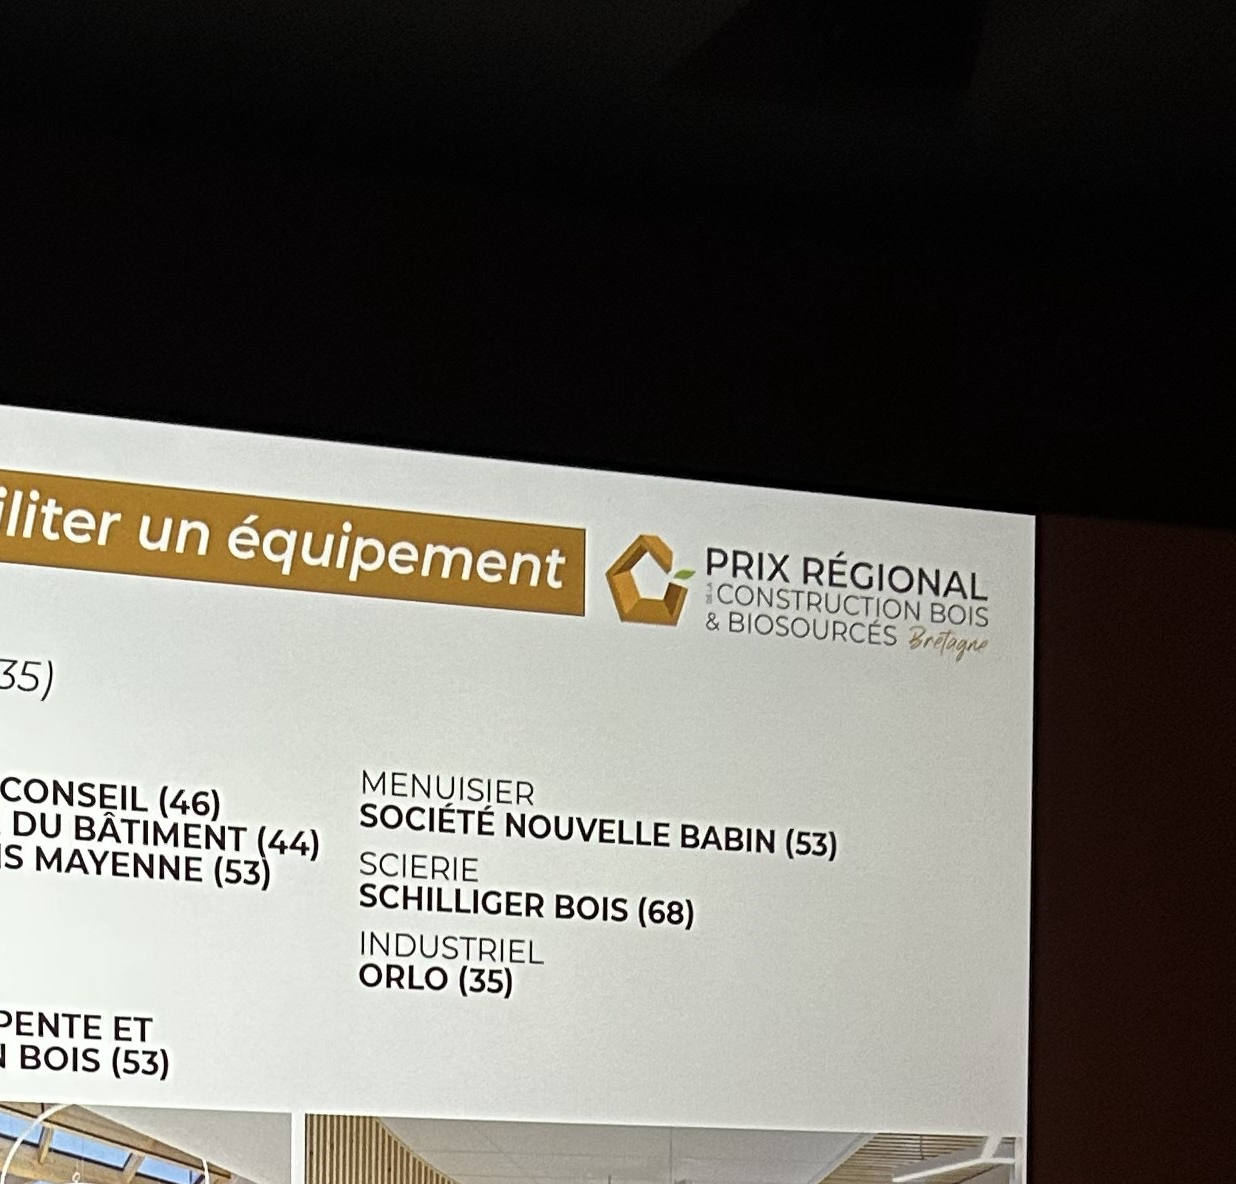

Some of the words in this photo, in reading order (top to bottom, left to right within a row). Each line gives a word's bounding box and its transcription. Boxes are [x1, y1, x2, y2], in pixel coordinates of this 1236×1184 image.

[138, 514, 210, 555] un
[227, 514, 566, 588] équipement
[706, 546, 790, 584] PRIX
[802, 550, 989, 602] RÉGIONAL
[716, 583, 922, 622] CONSTRUCTION
[930, 602, 989, 628] BOIS
[705, 611, 720, 632] &
[728, 610, 898, 647] BIOSOURCÉS
[908, 625, 989, 662] Bretagne
[0, 776, 149, 813] CONSEIL
[159, 785, 221, 823] (46)
[362, 769, 534, 807] MENUISIER
[12, 809, 62, 840] DU
[74, 810, 248, 853] BÂTIMENT
[257, 825, 320, 862] (44)
[359, 802, 496, 837] SOCIÉTÉ
[505, 812, 671, 848] NOUVELLE
[680, 823, 776, 854] BABIN
[785, 827, 837, 863] (53)
[35, 845, 203, 883] MAYENNE
[213, 855, 272, 892] (53)
[359, 850, 479, 883] SCIERIE
[359, 882, 545, 919] SCHILLIGER
[554, 893, 629, 923] BOIS
[638, 896, 694, 931] (68)
[360, 930, 545, 966] INDUSTRIEL
[358, 962, 449, 992] ORLO
[458, 964, 513, 1000] (35)
[113, 1015, 154, 1044] ET
[19, 1043, 101, 1074] BOIS
[111, 1045, 170, 1082] (53)
